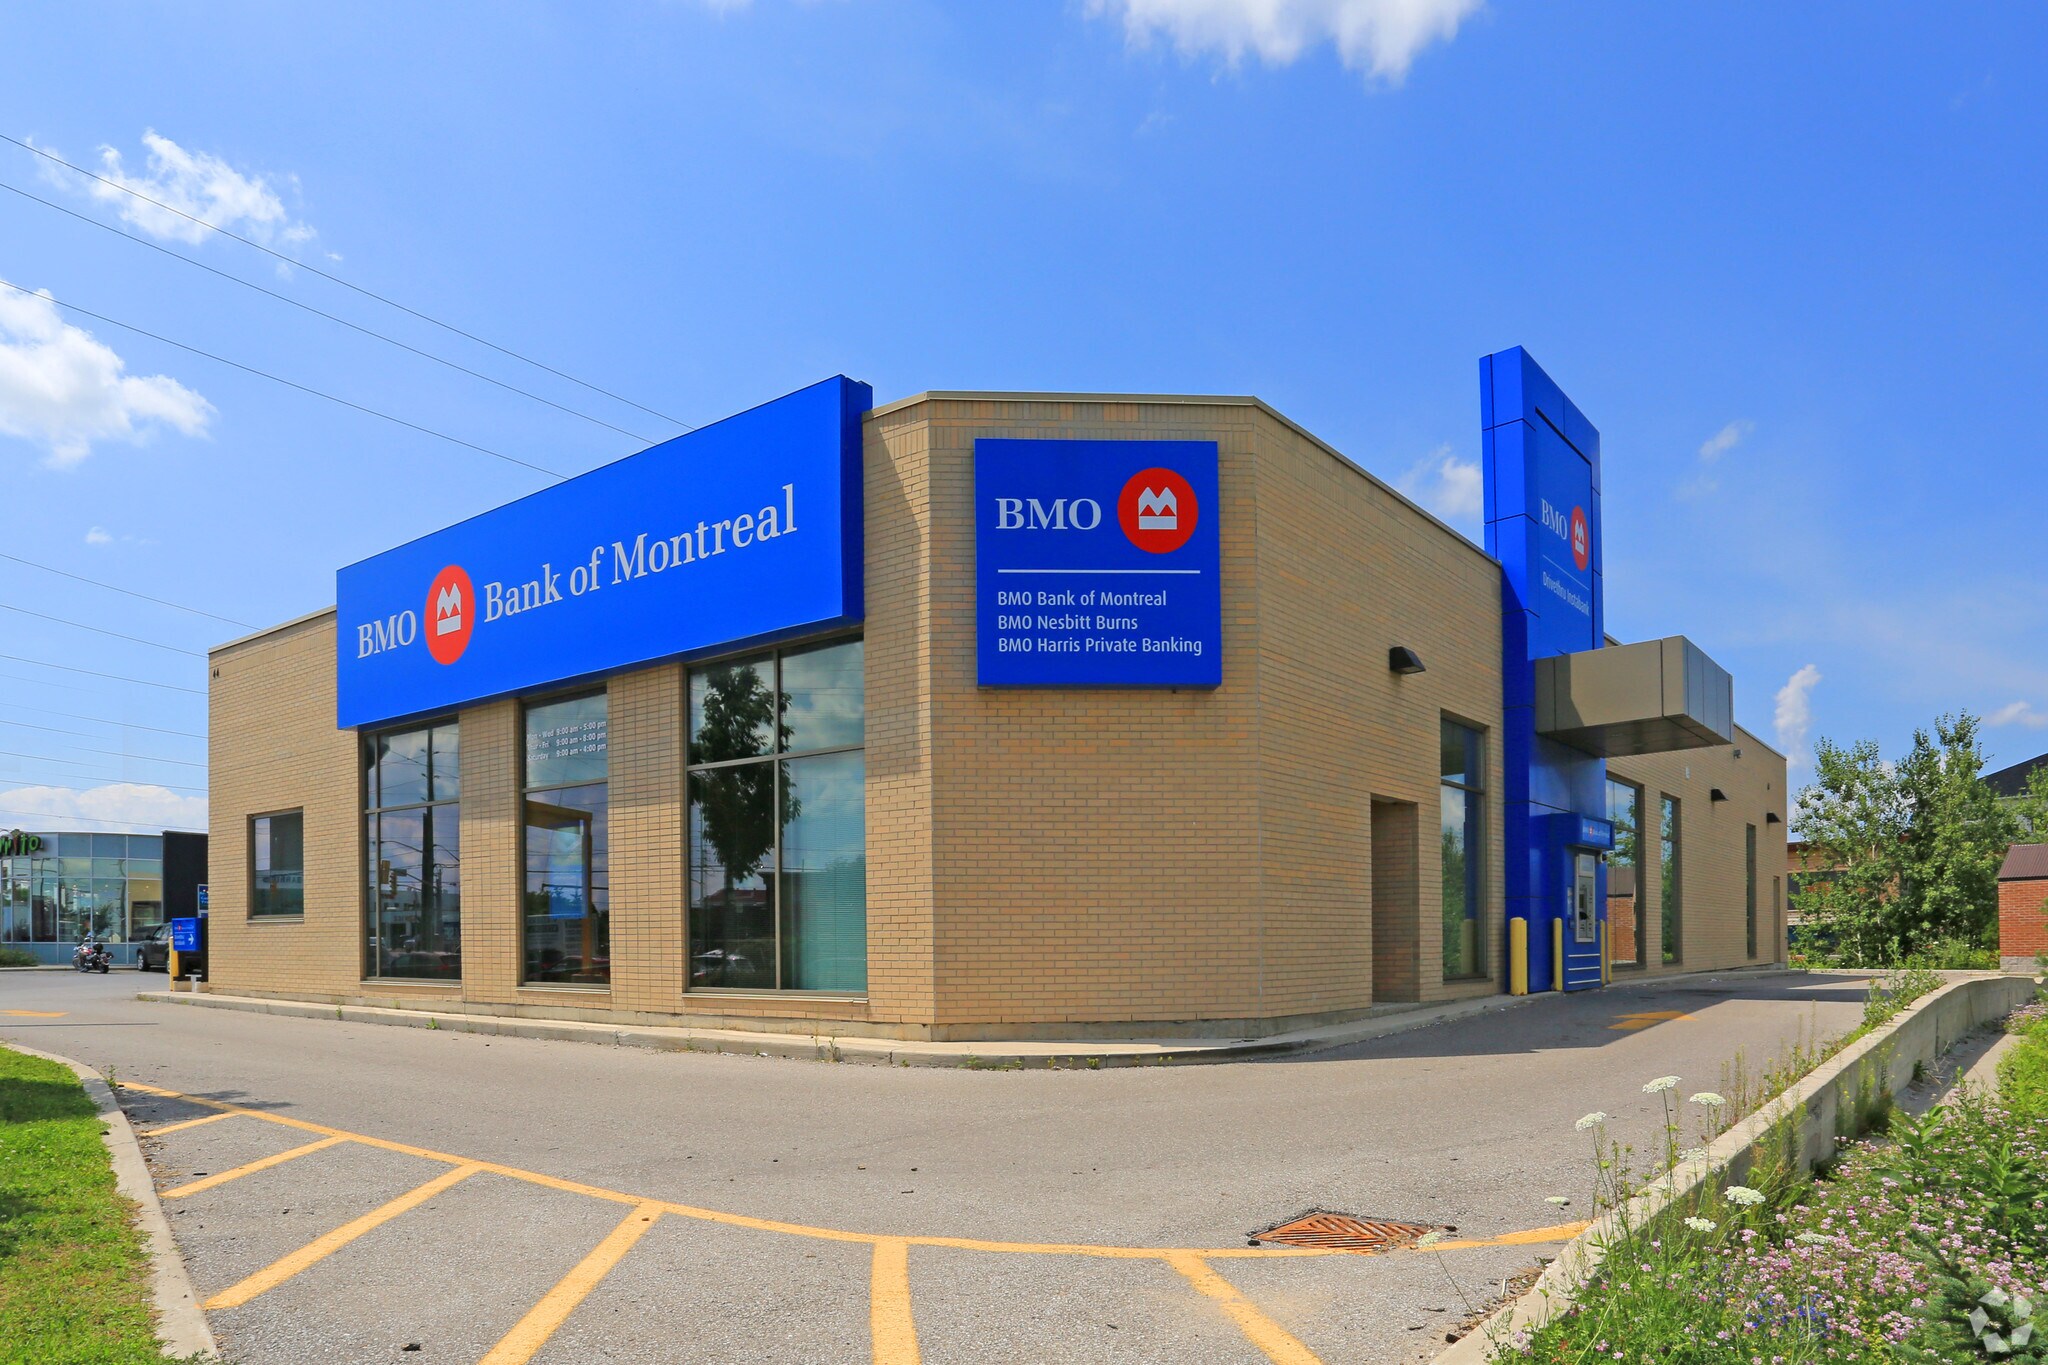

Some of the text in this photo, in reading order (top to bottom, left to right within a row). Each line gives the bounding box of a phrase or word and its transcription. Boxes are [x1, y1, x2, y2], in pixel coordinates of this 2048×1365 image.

[995, 498, 1102, 530] BMO
[1541, 498, 1567, 540] BMO
[357, 483, 798, 659] BMO Bank of Montreal
[998, 590, 1167, 606] BMO Bank of Montreal
[998, 614, 1138, 630] BMO Nesbitt Burns
[998, 637, 1202, 656] BMO Harris Private Banking
[542, 730, 554, 738] Wed
[556, 726, 569, 736] 9:00
[583, 721, 597, 731] 5:00
[597, 721, 607, 729] pm
[556, 737, 569, 747] 9:00
[583, 733, 596, 742] 8:00
[597, 732, 607, 741] pm
[556, 749, 569, 757] 9:00
[583, 744, 597, 753] 4:00
[597, 743, 607, 752] pm
